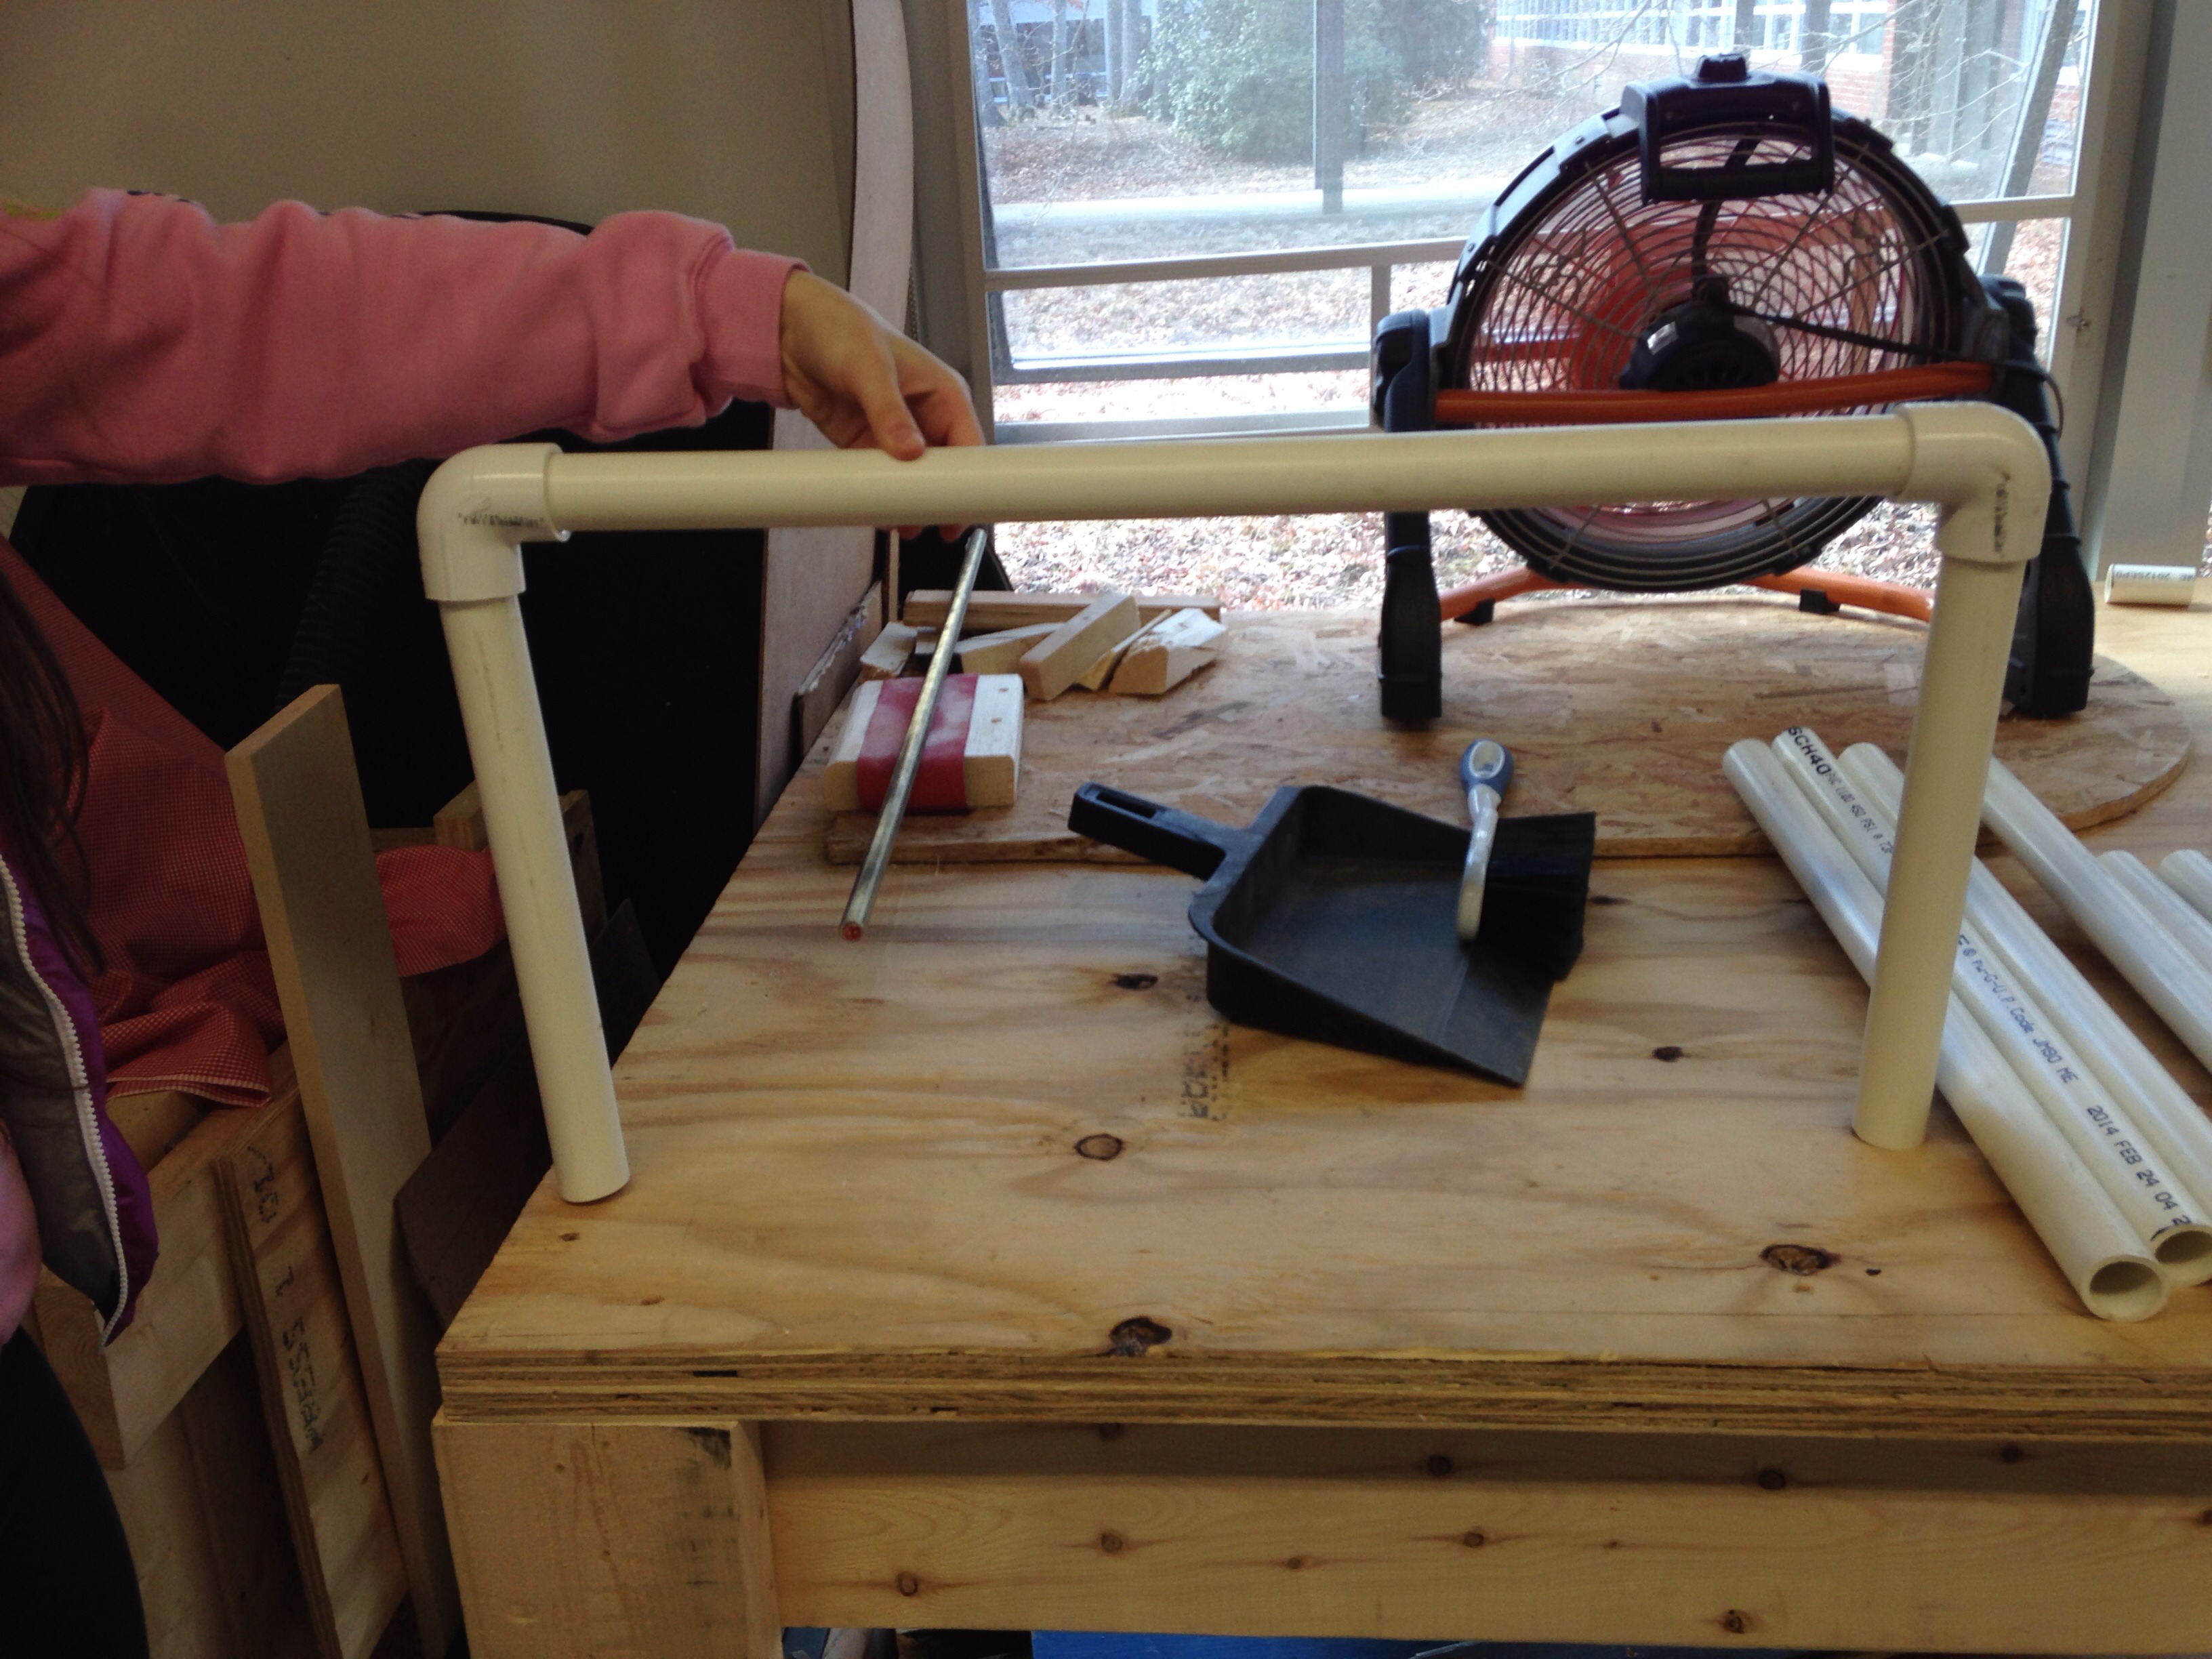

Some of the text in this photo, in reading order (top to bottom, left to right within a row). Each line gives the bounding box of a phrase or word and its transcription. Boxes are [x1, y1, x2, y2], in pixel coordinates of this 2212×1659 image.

[1788, 726, 1832, 775] SCH40
[2086, 1105, 2119, 1136] 2014
[2114, 1140, 2142, 1164] FEB
[2135, 1170, 2160, 1187] 24
[2154, 1191, 2177, 1210] 04
